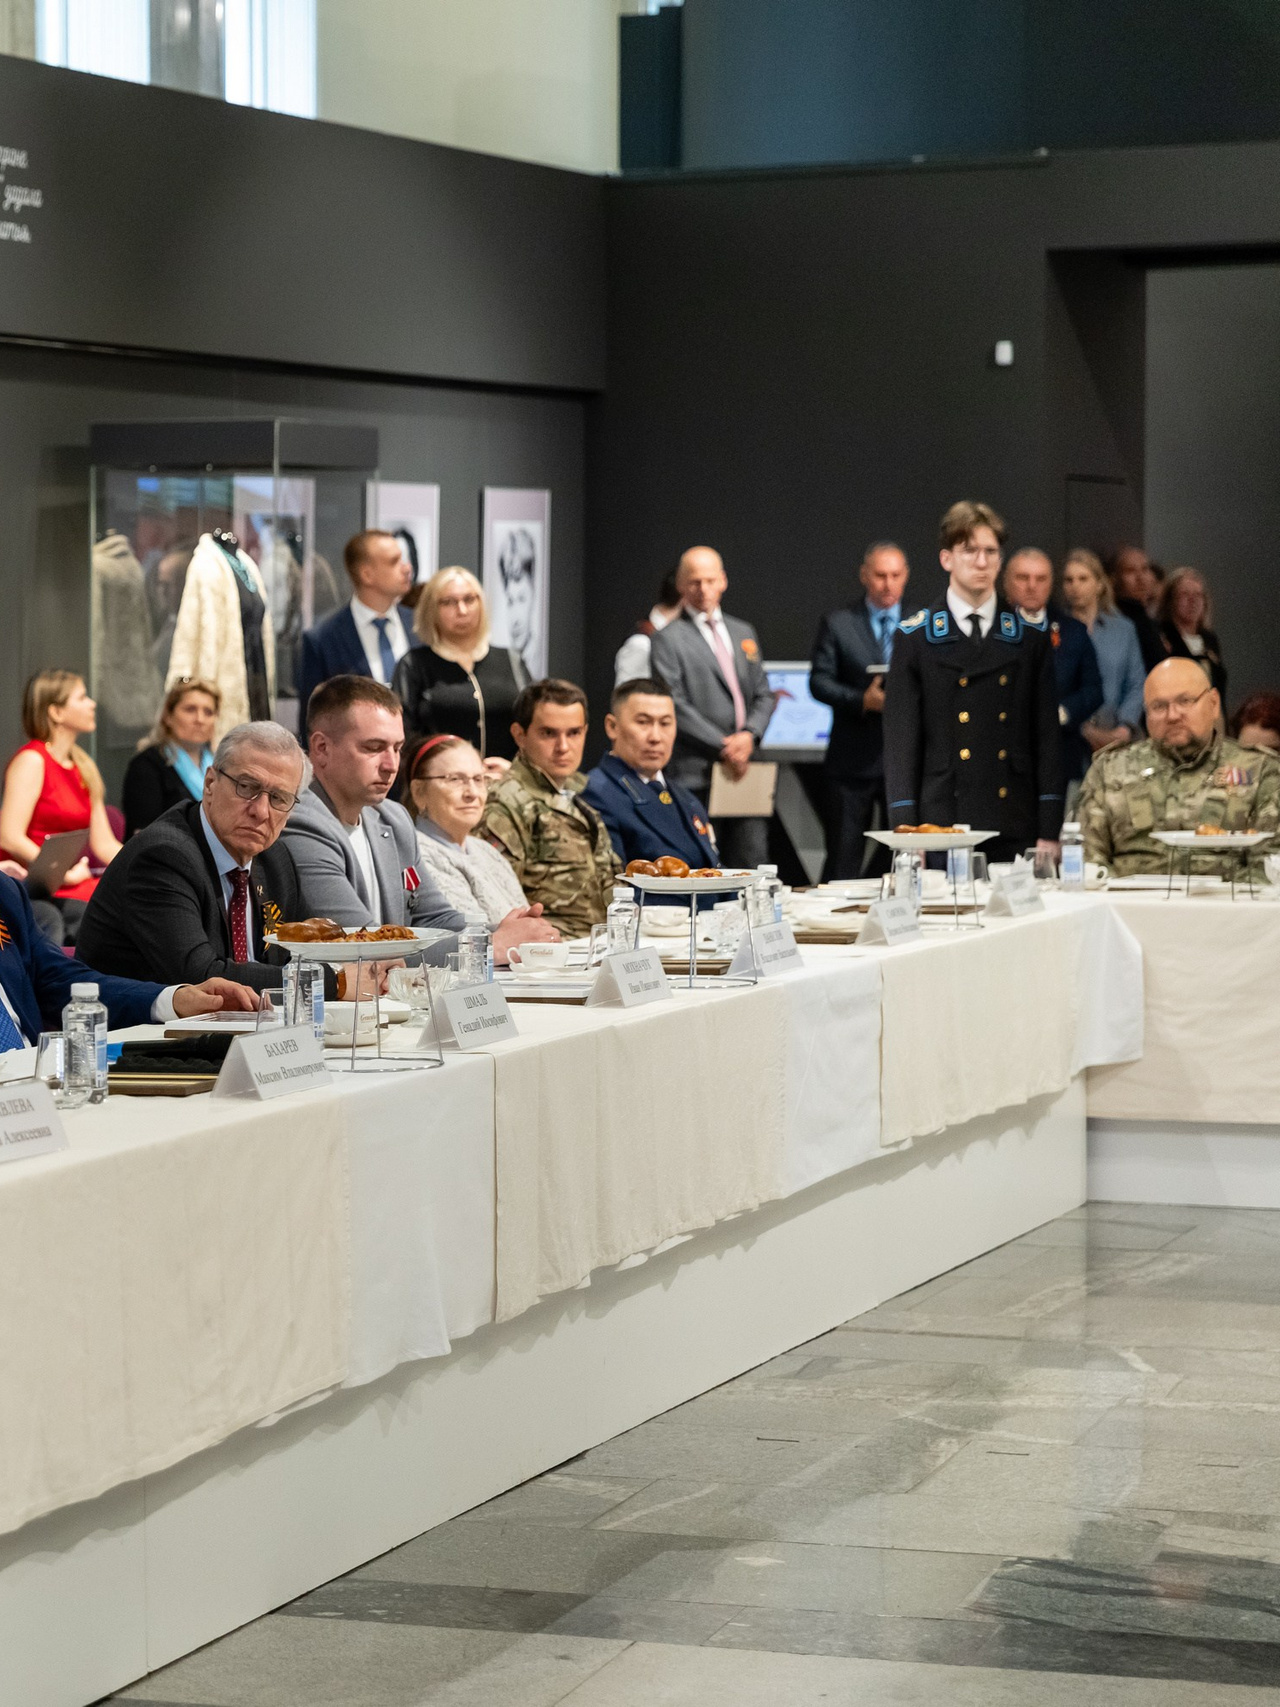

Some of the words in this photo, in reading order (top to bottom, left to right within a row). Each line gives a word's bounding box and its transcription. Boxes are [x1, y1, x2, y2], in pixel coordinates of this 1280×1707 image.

[464, 993, 488, 1009] ШМАЛЬ
[264, 1039, 299, 1058] БАХАРЕВ
[254, 1071, 282, 1086] Максим
[280, 1061, 327, 1078] Владимирович
[4, 1126, 52, 1145] Алексеевна
